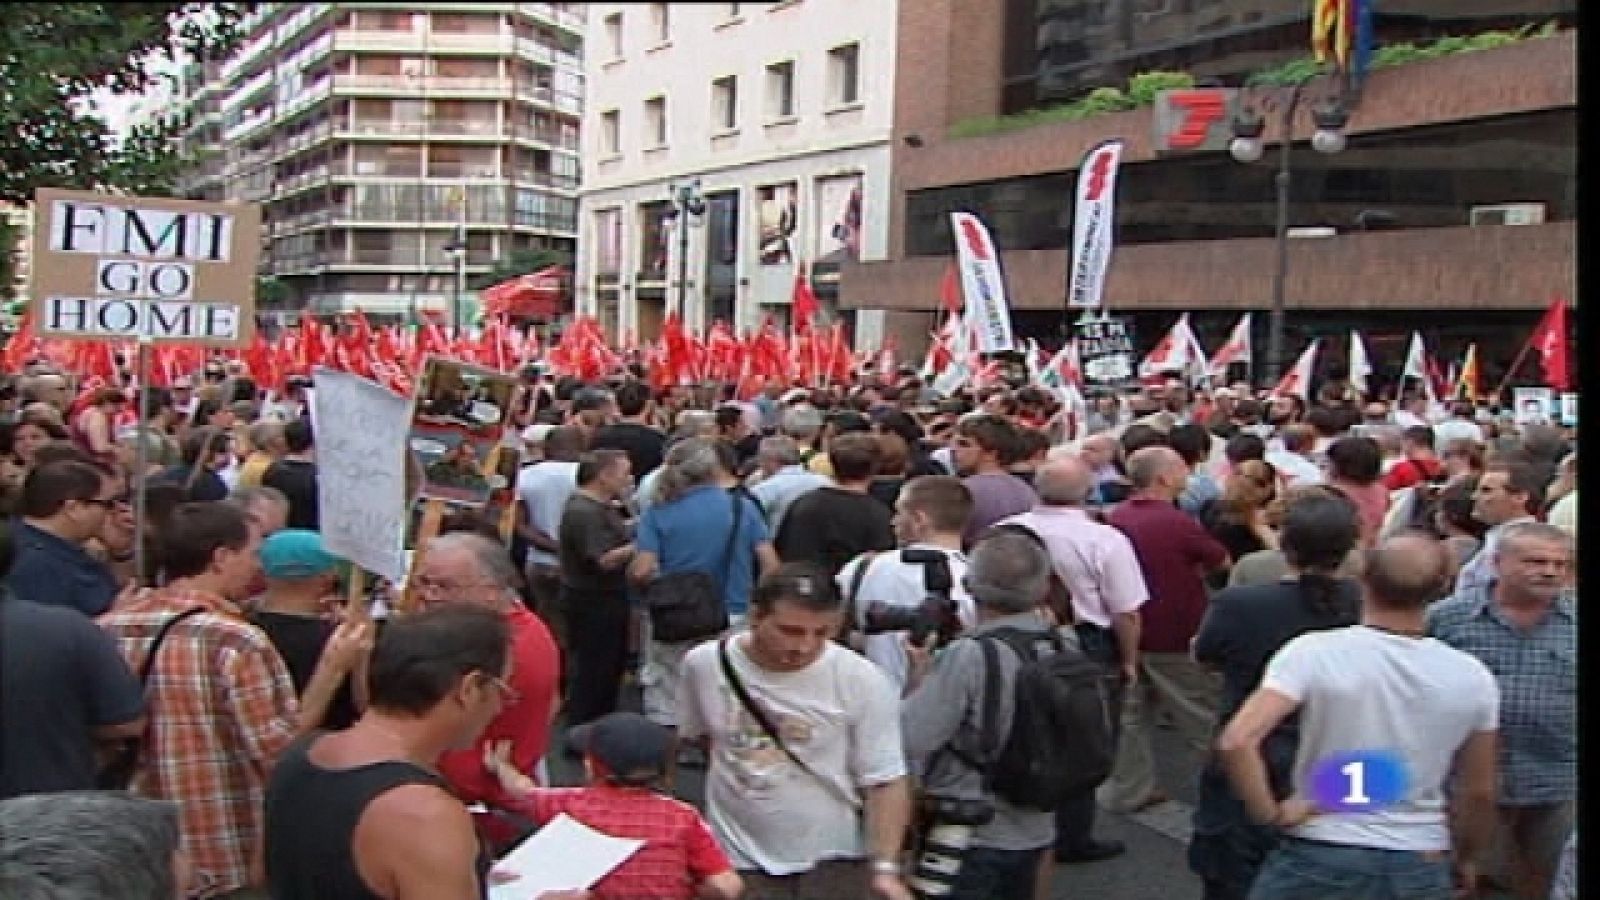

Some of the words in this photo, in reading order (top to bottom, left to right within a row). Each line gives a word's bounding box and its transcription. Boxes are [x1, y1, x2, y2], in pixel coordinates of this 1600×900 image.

[62, 202, 222, 260] FMI
[100, 261, 190, 297] GO
[50, 299, 233, 338] HOME
